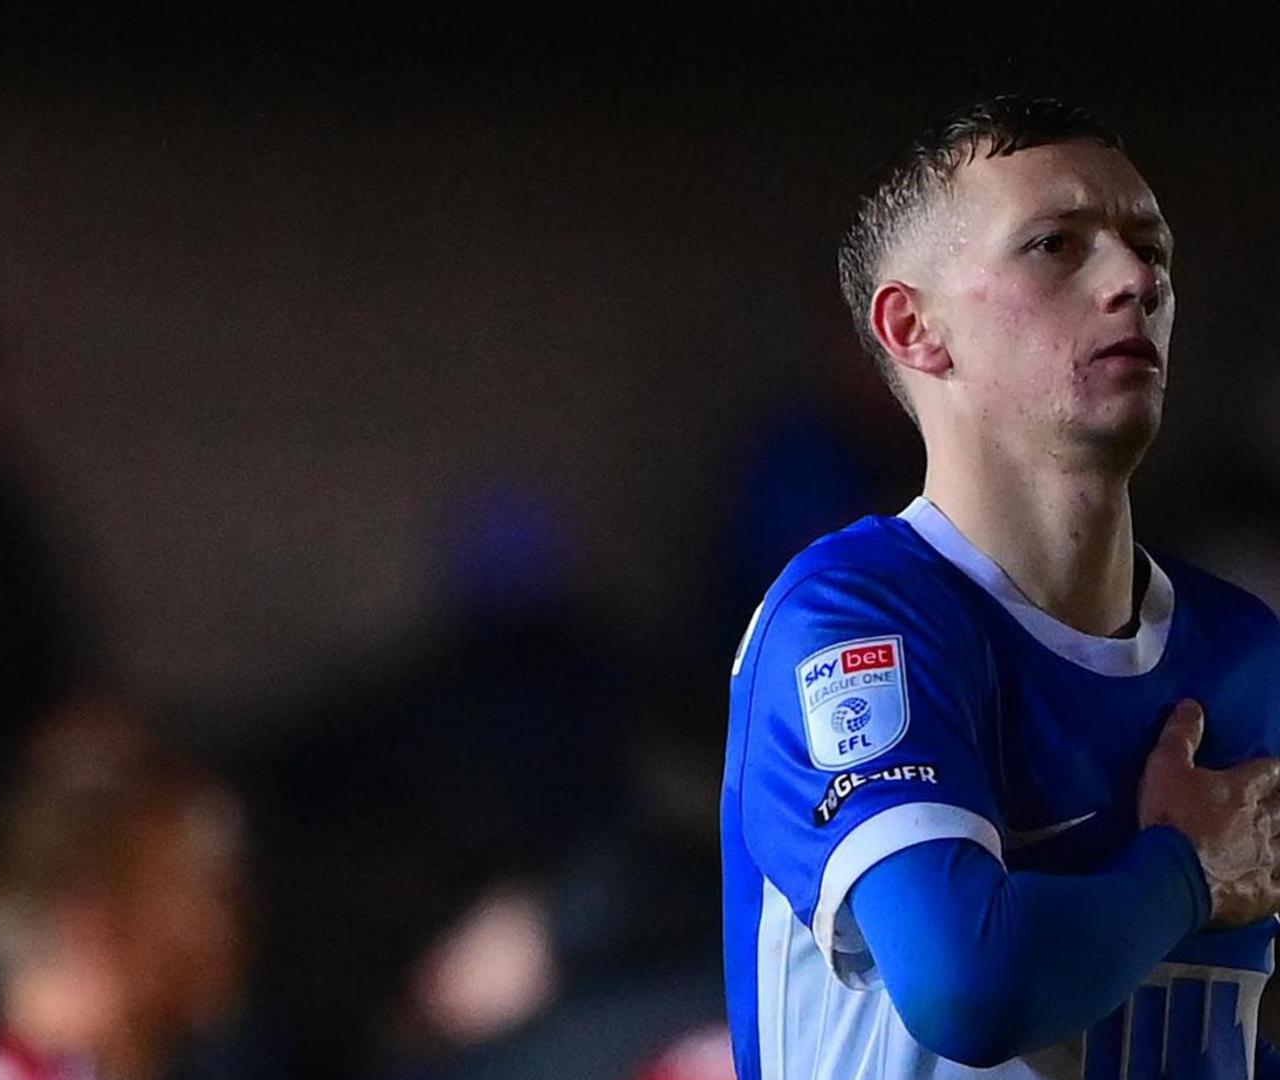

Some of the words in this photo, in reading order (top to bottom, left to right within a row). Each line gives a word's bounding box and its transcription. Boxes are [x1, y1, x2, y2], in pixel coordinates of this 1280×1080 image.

[805, 659, 838, 688] sky
[846, 648, 889, 668] bet
[810, 676, 857, 707] LEAGUE
[862, 671, 894, 684] ONE
[838, 734, 872, 756] EFL
